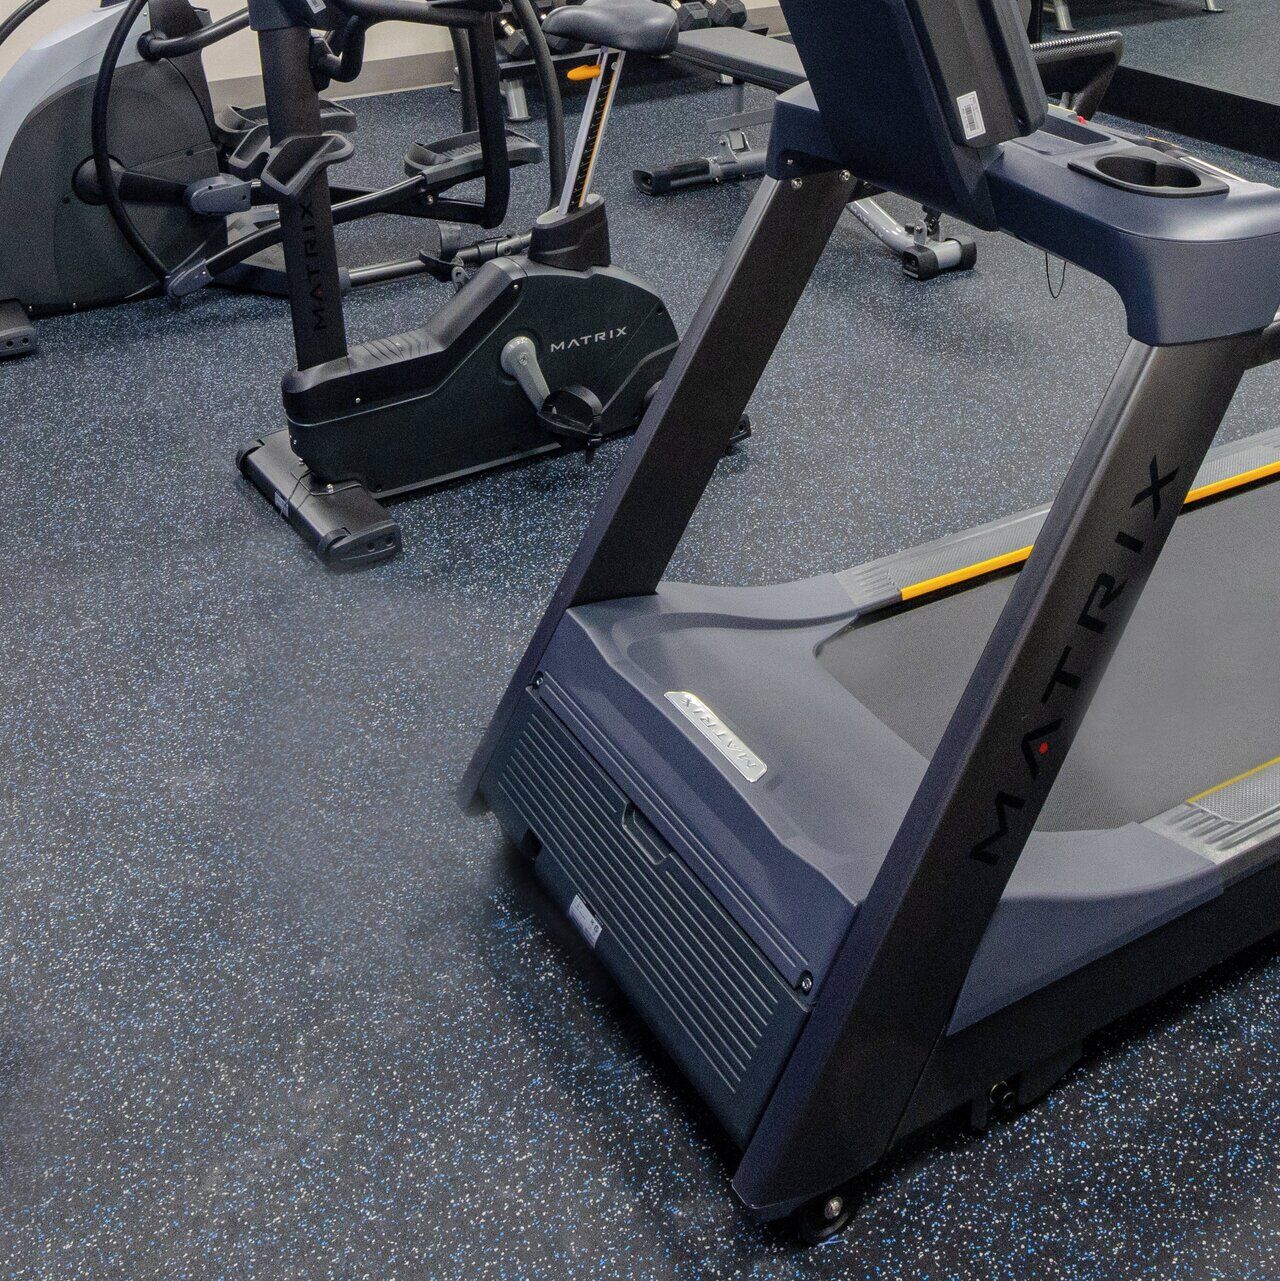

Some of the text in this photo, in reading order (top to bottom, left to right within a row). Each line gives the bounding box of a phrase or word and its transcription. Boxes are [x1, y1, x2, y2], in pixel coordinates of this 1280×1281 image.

[299, 202, 327, 331] MATRIX
[550, 326, 627, 353] MATRIX
[969, 454, 1180, 867] MATRIX
[680, 696, 757, 770] MATRIX
